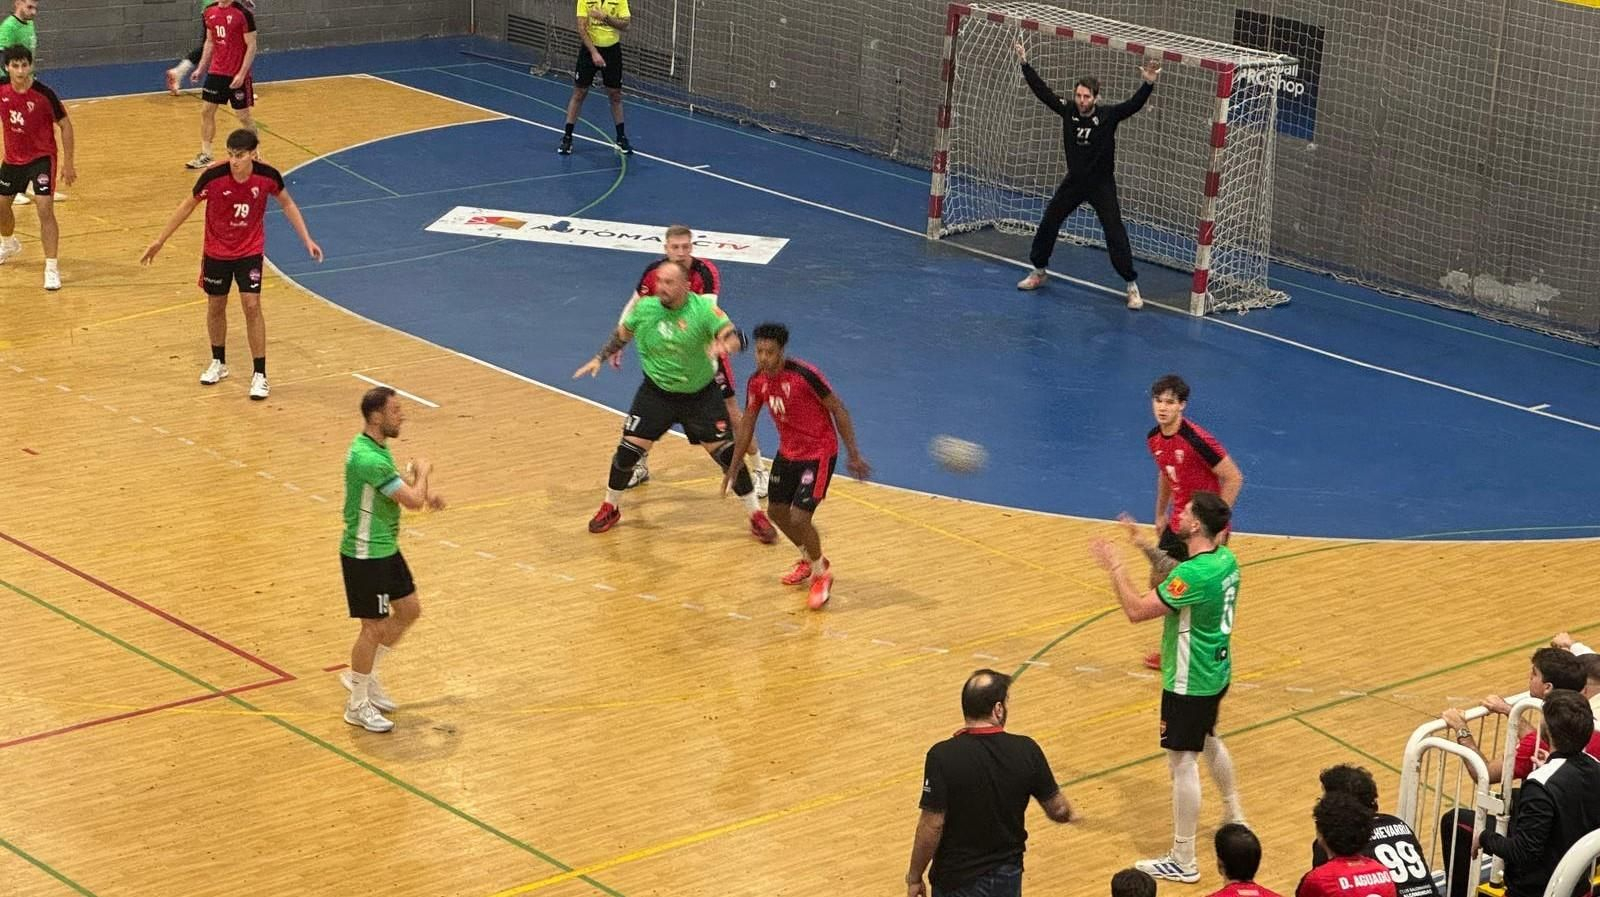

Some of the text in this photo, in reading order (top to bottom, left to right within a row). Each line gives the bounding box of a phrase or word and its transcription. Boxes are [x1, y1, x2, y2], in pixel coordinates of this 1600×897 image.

[215, 25, 226, 38] 10
[9, 109, 25, 126] 34
[1076, 127, 1092, 139] 27
[233, 203, 250, 218] 79
[1374, 840, 1427, 883] 99
[1353, 870, 1391, 888] AGUADO
